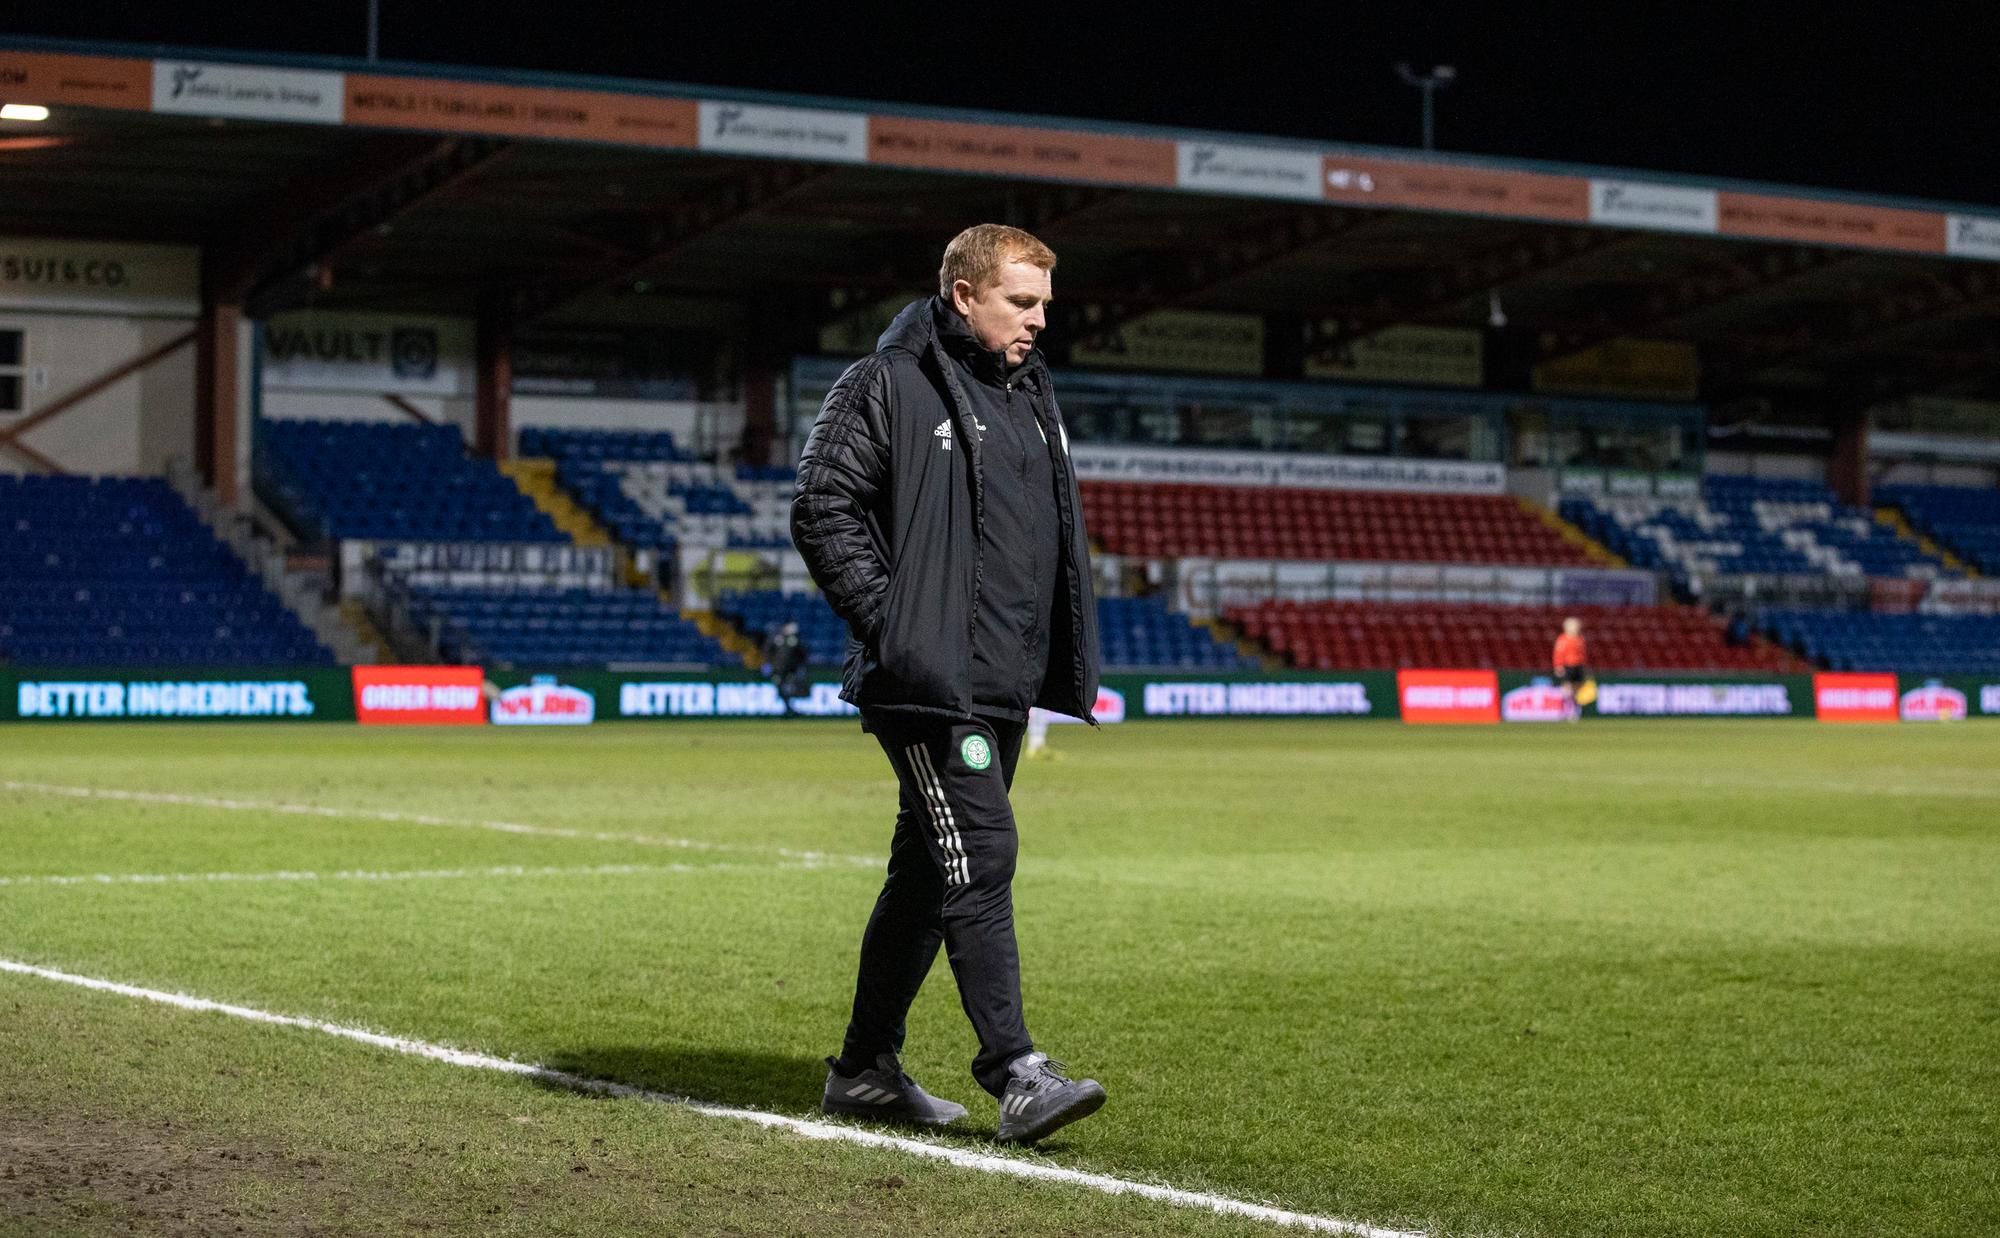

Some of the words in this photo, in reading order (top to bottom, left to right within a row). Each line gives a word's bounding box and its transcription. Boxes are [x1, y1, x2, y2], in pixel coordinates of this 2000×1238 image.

[265, 328, 383, 362] VAULT
[18, 681, 126, 717] BETTER
[362, 684, 429, 710] ORDER
[431, 685, 480, 711] NOW
[620, 682, 715, 716] BETTER
[1144, 683, 1226, 714] BETTER
